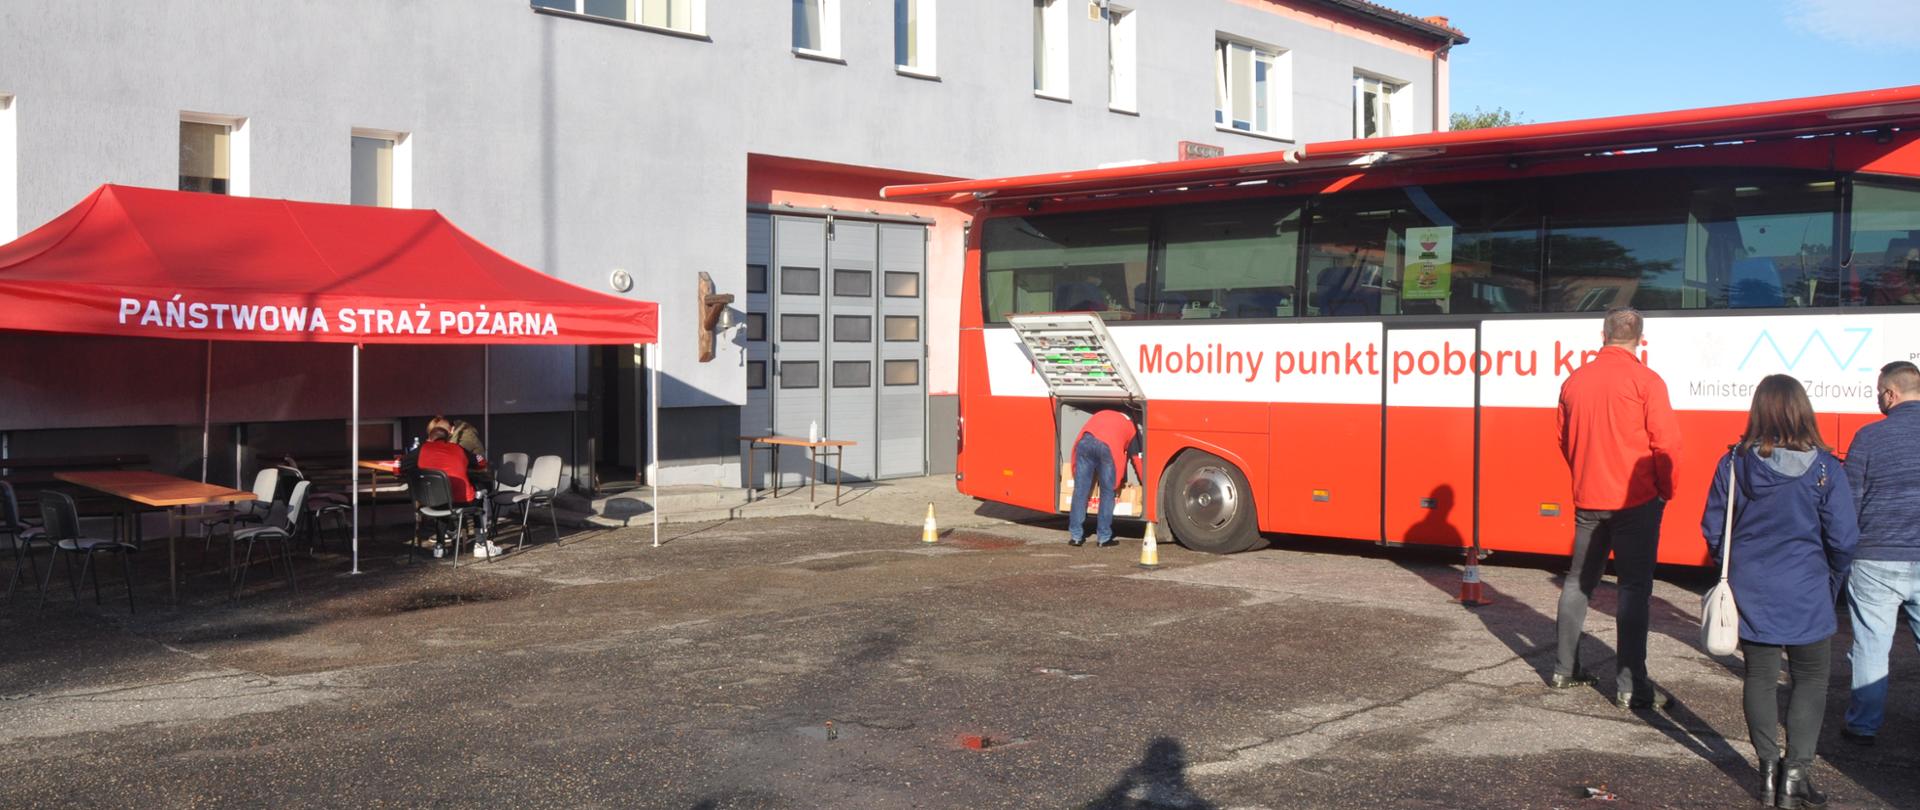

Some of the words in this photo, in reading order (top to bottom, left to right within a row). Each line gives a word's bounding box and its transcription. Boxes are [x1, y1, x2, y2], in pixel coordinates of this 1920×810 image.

[118, 294, 330, 333] PAŃSTWOWA
[338, 303, 432, 335] STRAŻ
[440, 304, 559, 336] POŻARNA
[1139, 343, 1264, 382] Mobilny
[1275, 342, 1379, 383] punkt
[1393, 341, 1537, 385] poboru
[1554, 340, 1649, 377] kri
[1689, 381, 1756, 397] Minister
[1804, 380, 1873, 398] Zdrowia
